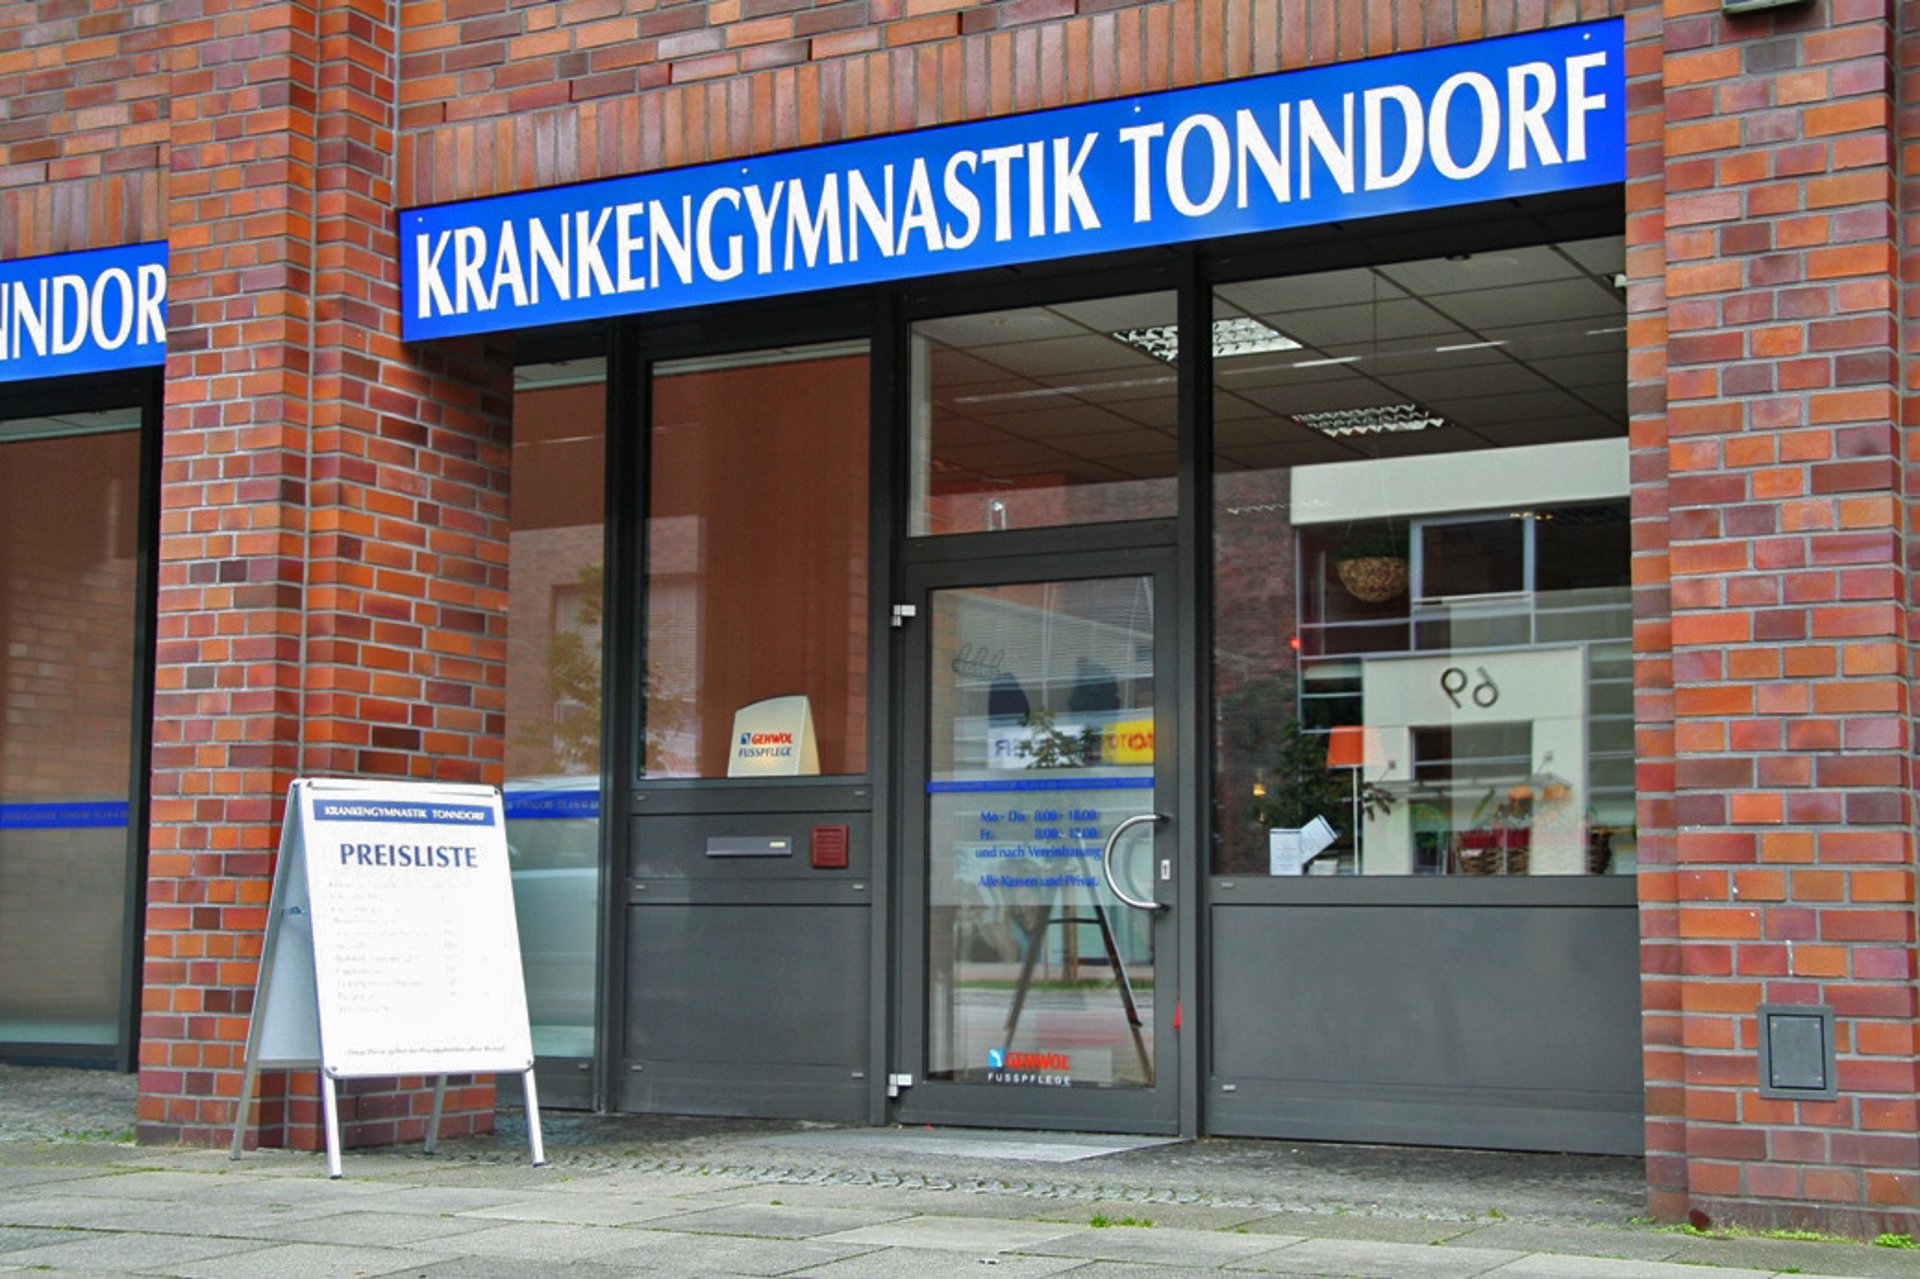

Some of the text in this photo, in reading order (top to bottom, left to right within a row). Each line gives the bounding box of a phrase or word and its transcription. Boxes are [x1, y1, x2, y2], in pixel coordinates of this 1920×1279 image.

[417, 52, 1606, 319] KRANKENGYMNASTIK TONNDORF
[738, 747, 791, 757] FUSSPFLEGE
[324, 806, 484, 821] KRANKENGYMNASTIK TONNDORF
[340, 844, 478, 868] PREISLISTE
[976, 845, 1101, 860] und nach Vereinbarung
[987, 1073, 1071, 1086] FUSSPFLEGE
